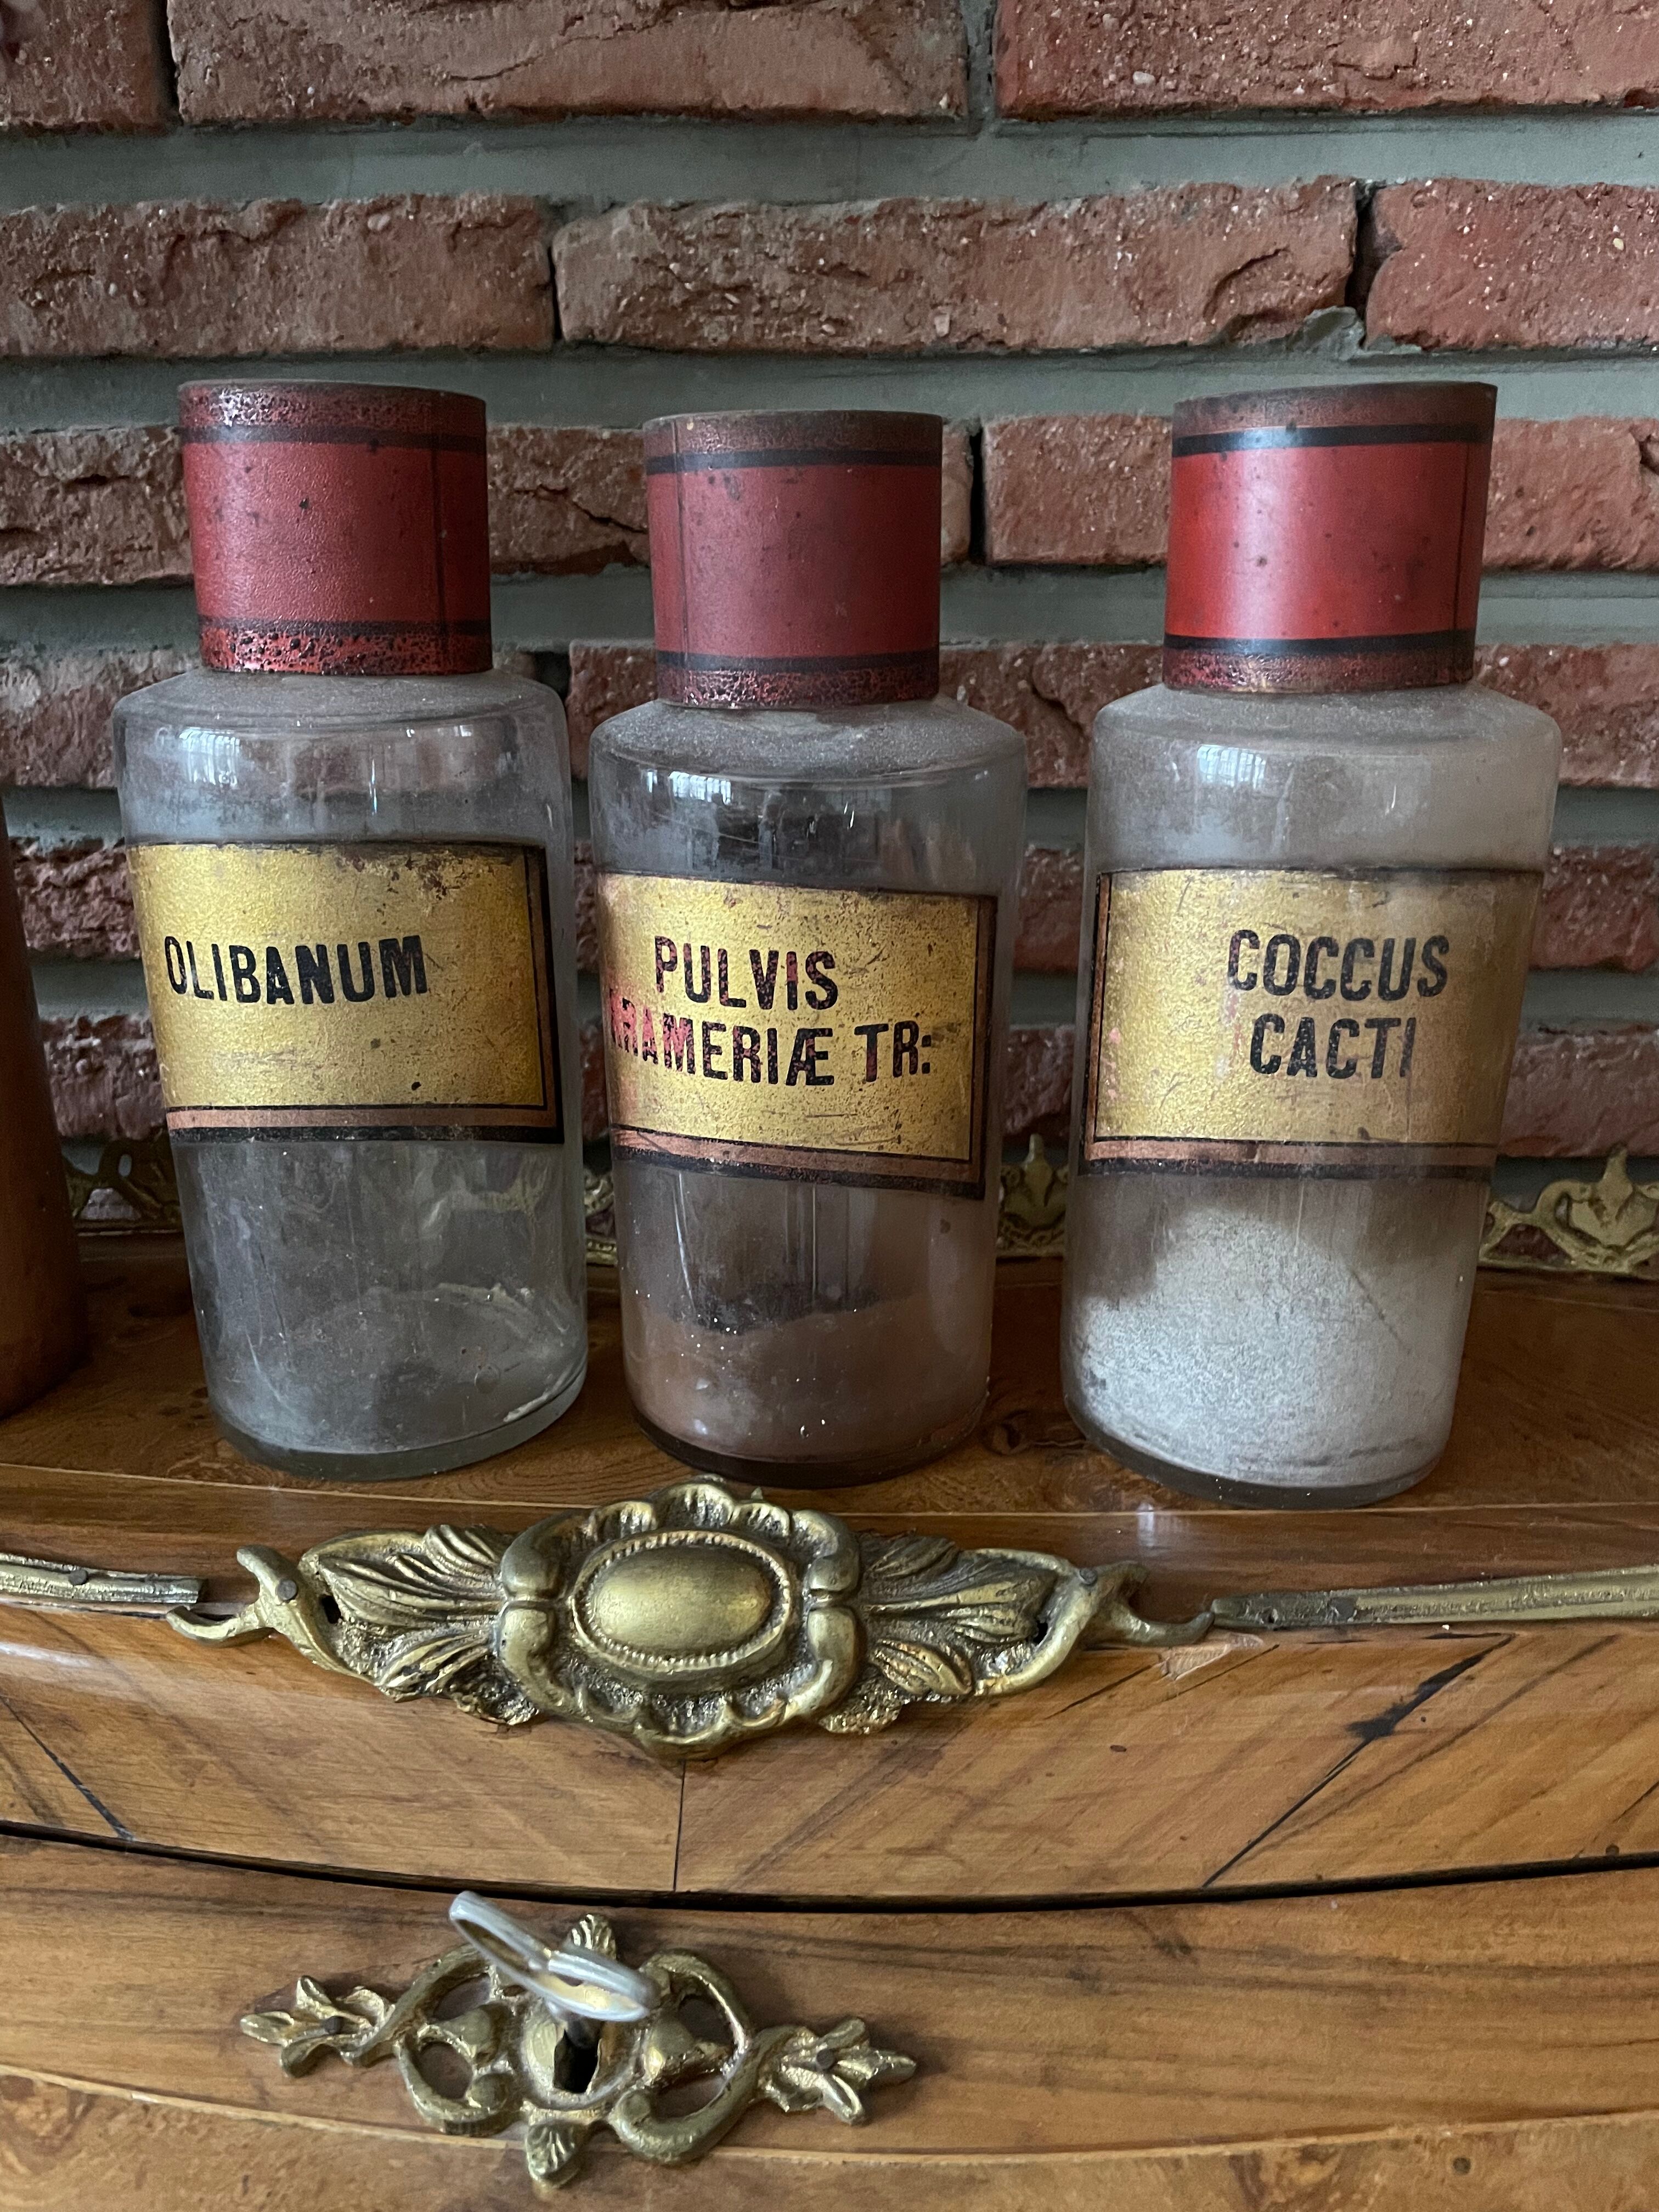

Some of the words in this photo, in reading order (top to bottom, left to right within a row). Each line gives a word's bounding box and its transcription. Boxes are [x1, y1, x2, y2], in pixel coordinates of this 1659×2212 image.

[164, 935, 428, 1005] OLIBANUM
[654, 935, 838, 1010] PULVIS
[1227, 929, 1450, 1001] COCCUS
[854, 1020, 932, 1082] TR:
[1249, 1013, 1417, 1079] CACTI
